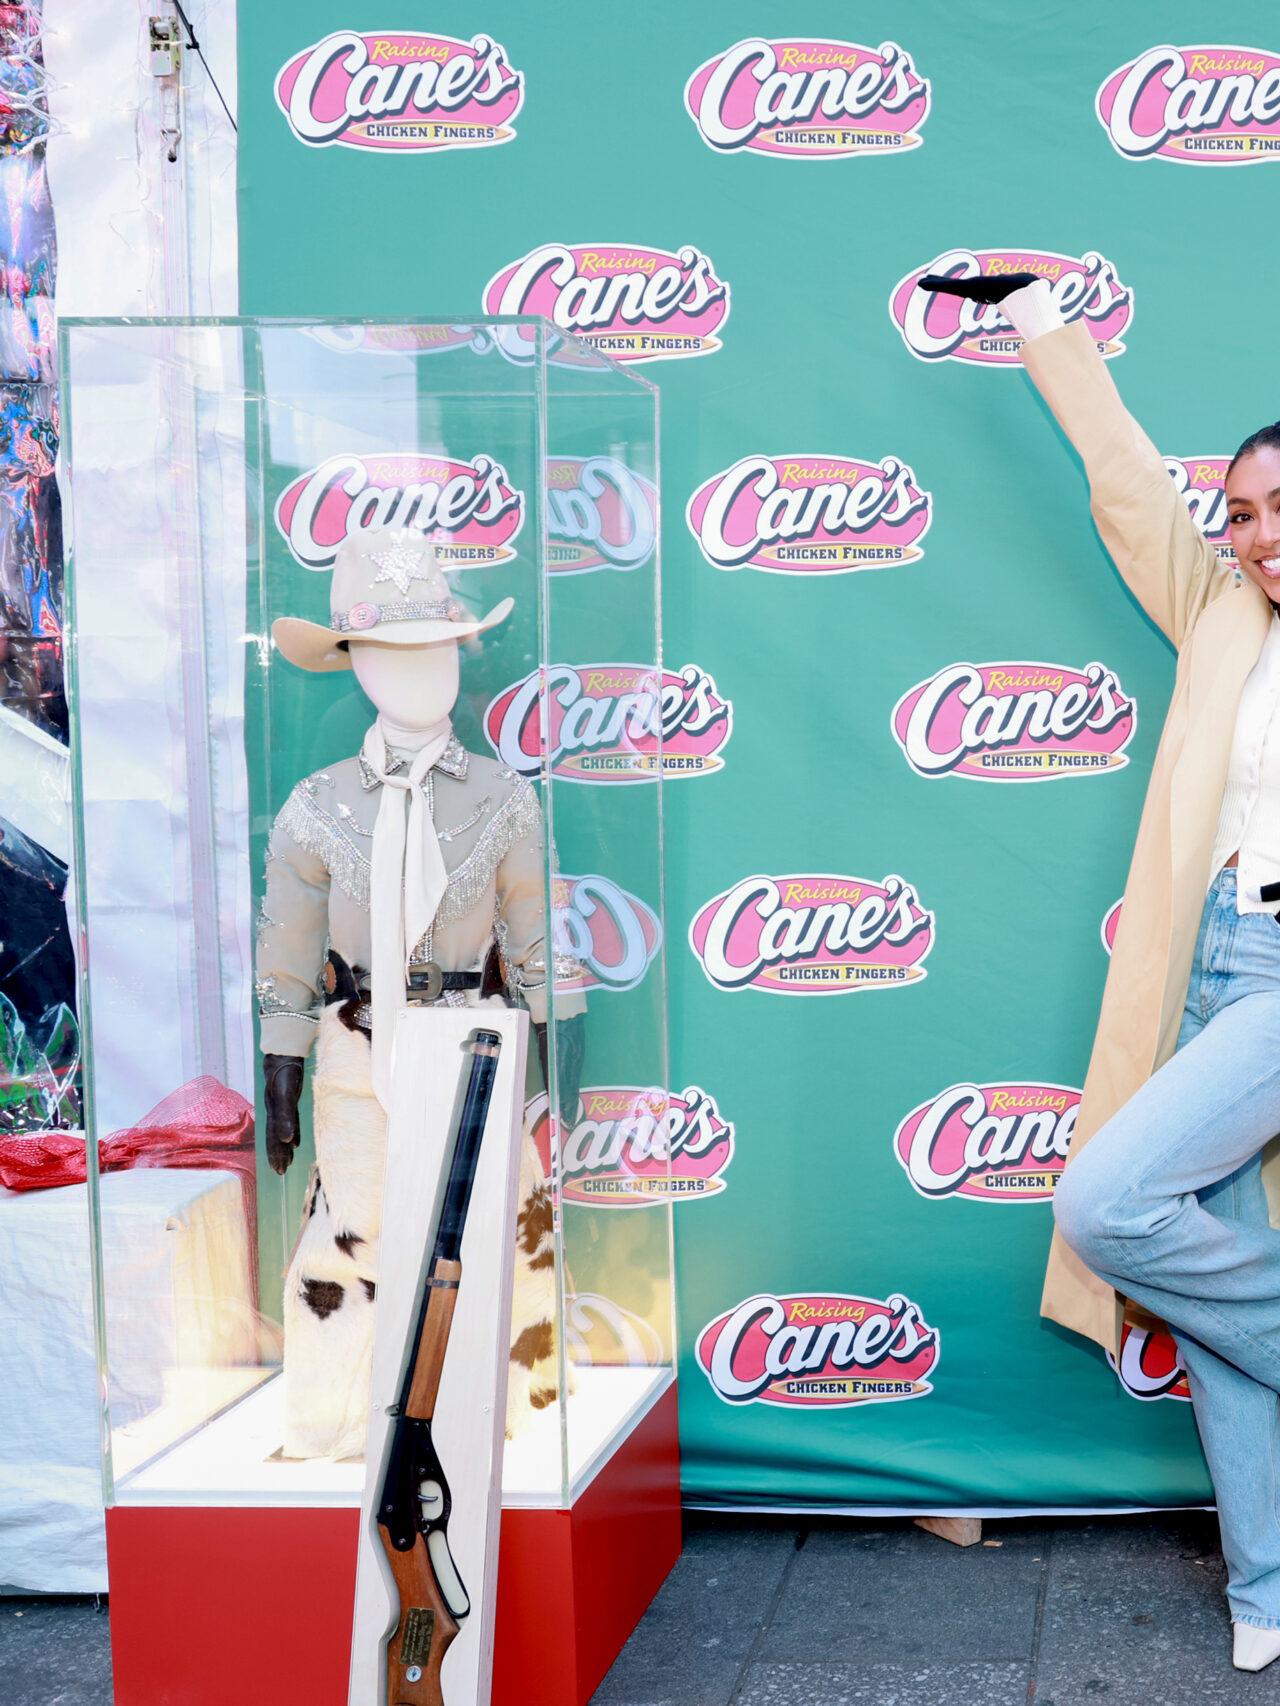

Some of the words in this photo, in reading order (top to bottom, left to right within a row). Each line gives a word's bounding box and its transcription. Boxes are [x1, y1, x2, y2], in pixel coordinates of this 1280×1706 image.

[371, 39, 449, 62] Raising
[779, 47, 856, 70] Raising
[1189, 53, 1264, 76] Raising
[289, 32, 518, 141] Cane's
[698, 40, 924, 148] Cane's
[366, 124, 428, 137] CHICKEN
[433, 124, 494, 138] FINGERS
[774, 131, 835, 144] CHICKEN
[840, 132, 900, 145] FINGERS
[1184, 137, 1244, 150] CHICKEN
[579, 251, 656, 274] Raising
[498, 244, 724, 352] Cane's
[640, 336, 700, 349] FINGERS
[979, 338, 1022, 352] CHICK
[372, 460, 449, 483] Raising
[781, 462, 858, 485] Raising
[290, 453, 518, 562] Cane's
[701, 455, 925, 563] Cane's
[433, 546, 493, 559] FINGERS
[776, 546, 837, 559] CHICKEN
[842, 547, 902, 560] FINGERS
[987, 668, 1062, 691] Raising
[505, 662, 725, 774] Cane's
[907, 661, 1129, 771] Cane's
[982, 754, 1042, 767] CHICKEN
[1047, 754, 1106, 768] FINGERS
[784, 880, 861, 904] Raising
[704, 873, 928, 985] Cane's
[779, 967, 840, 981] CHICKEN
[845, 968, 905, 982] FINGERS
[990, 1091, 1067, 1112] Raising
[985, 1175, 1046, 1187] CHICKEN
[790, 1300, 865, 1322] Raising
[710, 1293, 932, 1398] Cane's
[785, 1381, 845, 1394] CHICKEN
[850, 1382, 909, 1395] FINGERS
